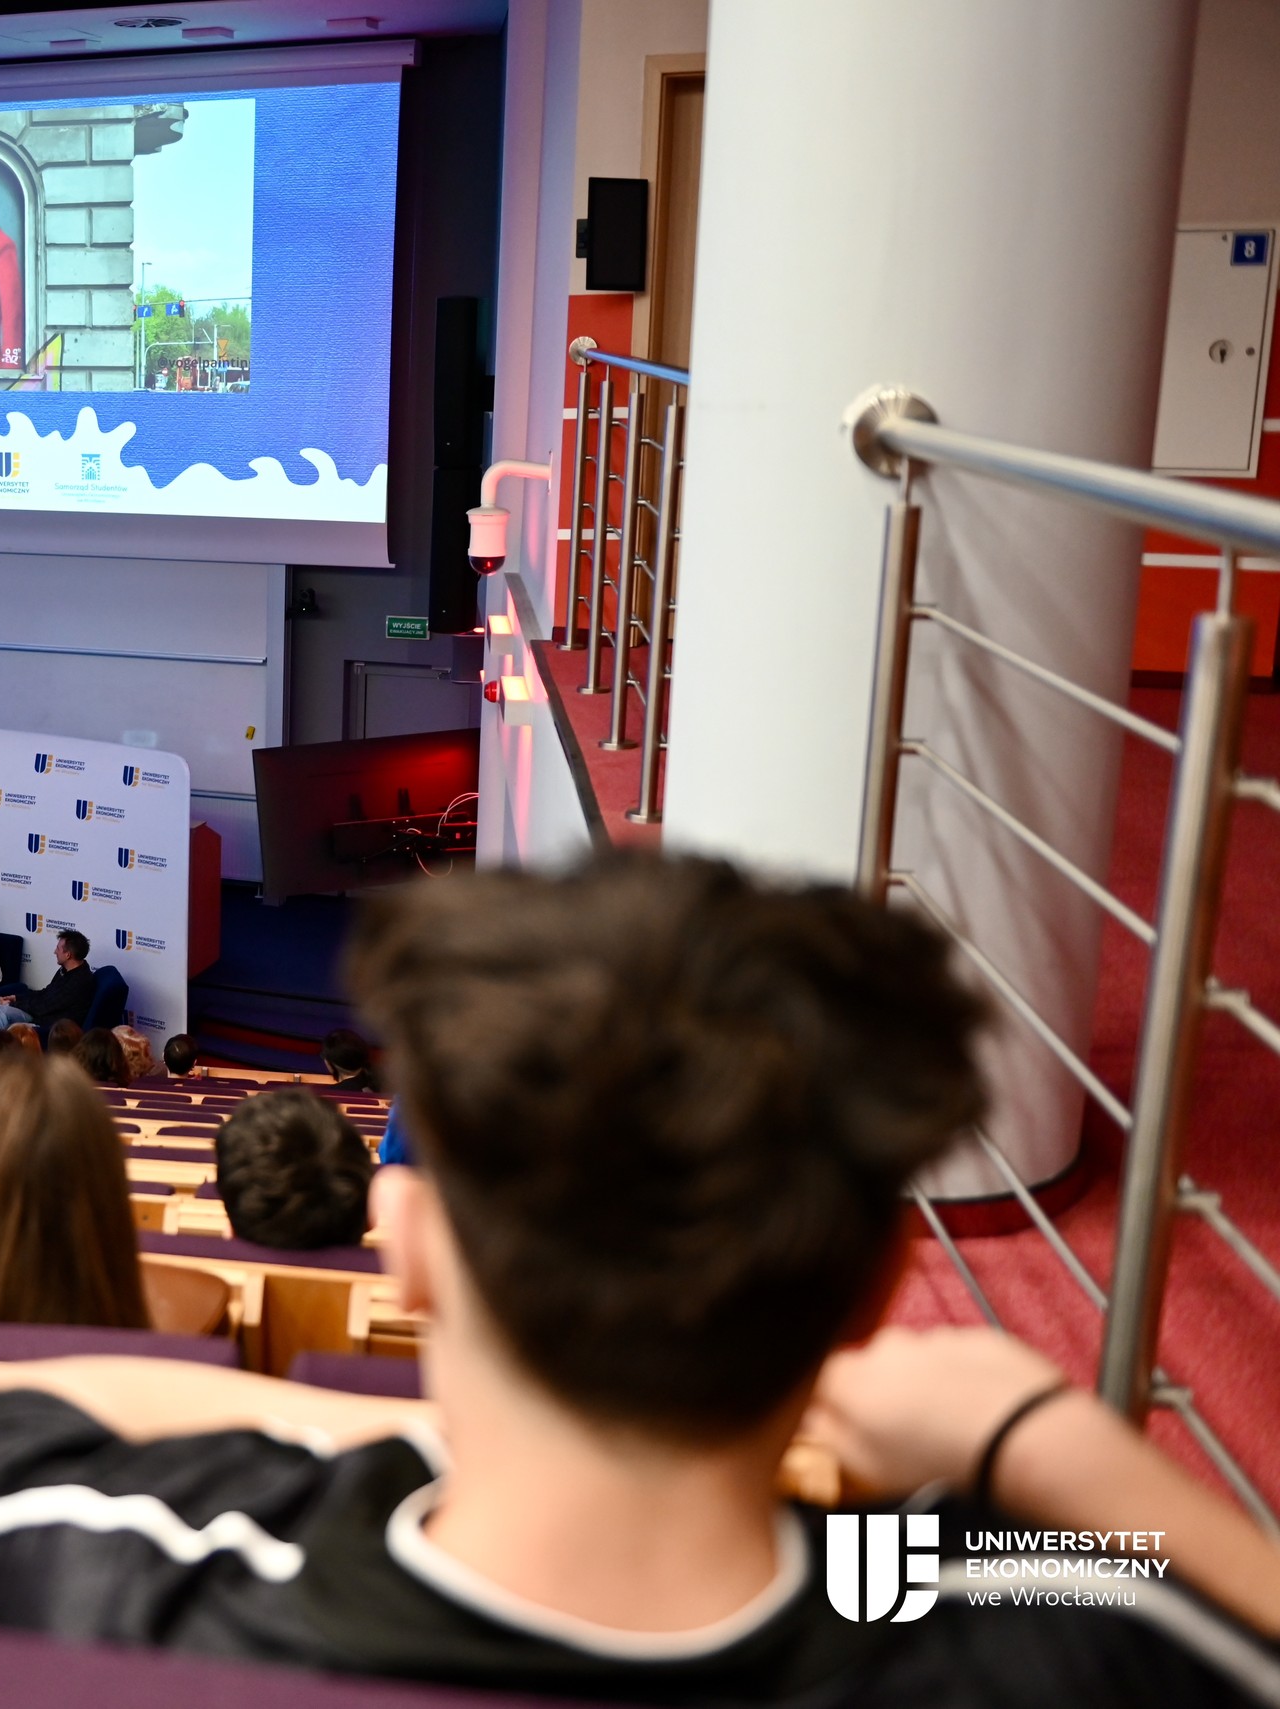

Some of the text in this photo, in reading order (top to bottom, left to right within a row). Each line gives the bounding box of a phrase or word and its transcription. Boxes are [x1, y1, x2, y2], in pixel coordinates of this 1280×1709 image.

[1244, 240, 1255, 258] 8
[158, 357, 250, 370] @vogelpaintin
[48, 844, 79, 852] EKONOMICZNY
